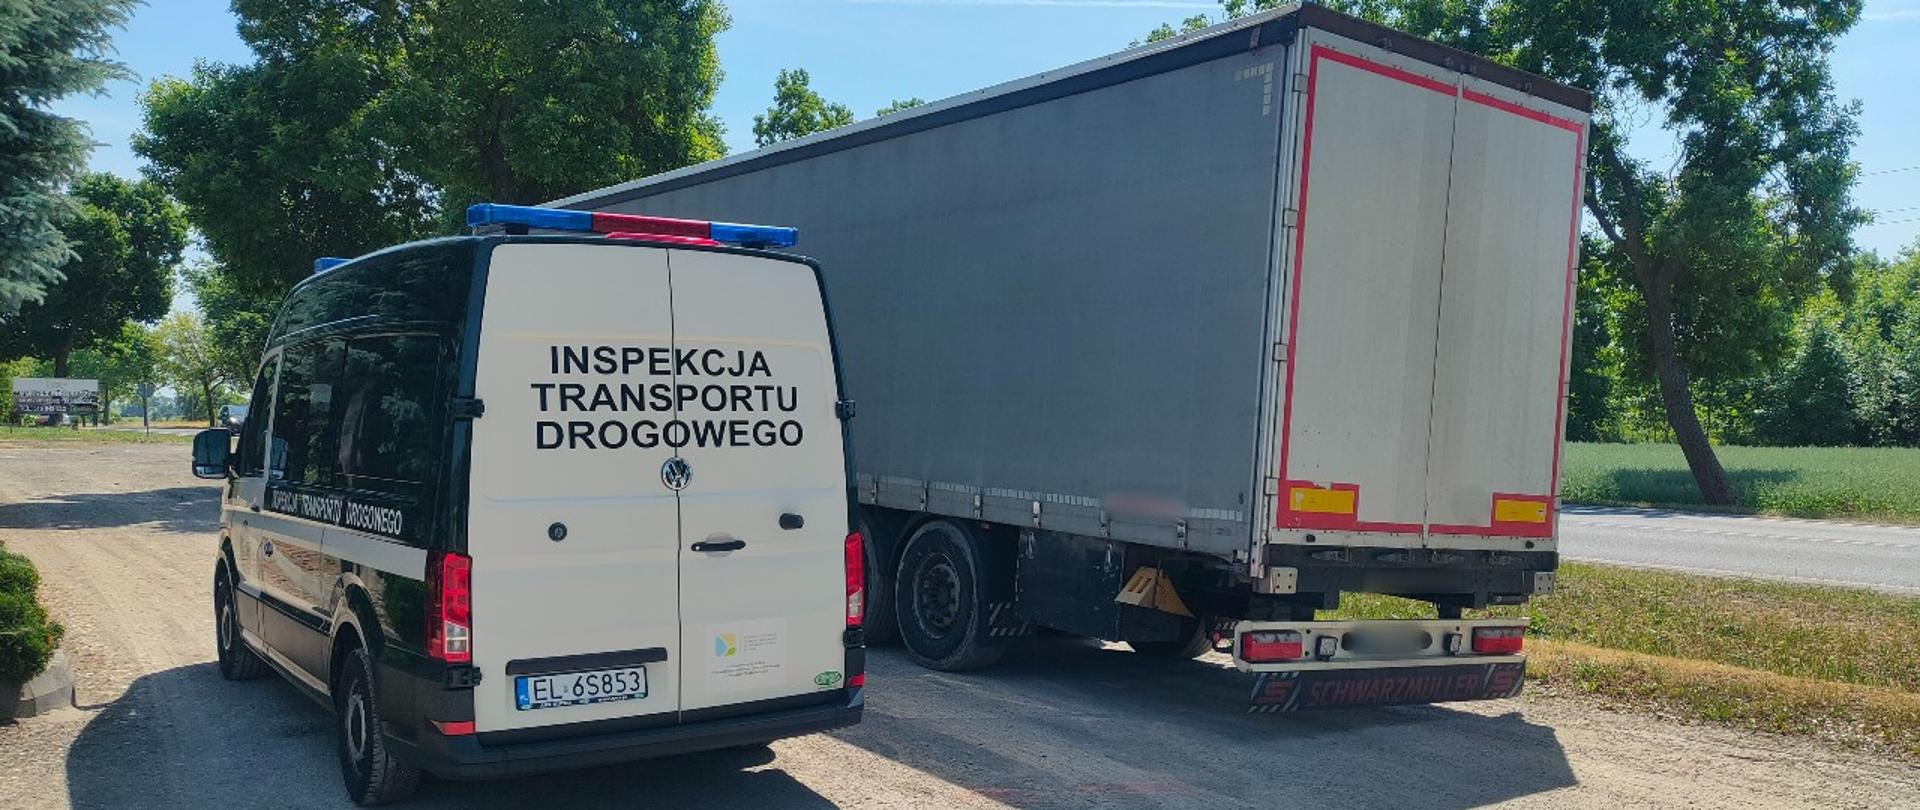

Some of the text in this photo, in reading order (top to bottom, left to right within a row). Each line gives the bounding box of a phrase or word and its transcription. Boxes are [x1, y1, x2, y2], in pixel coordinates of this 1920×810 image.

[550, 346, 772, 377] INSPEKCJA
[531, 383, 798, 412] TRANSPORTU
[536, 420, 804, 449] DROGOWEGO
[346, 502, 402, 535] DROGOWEGO
[533, 671, 640, 701] EL 6S853
